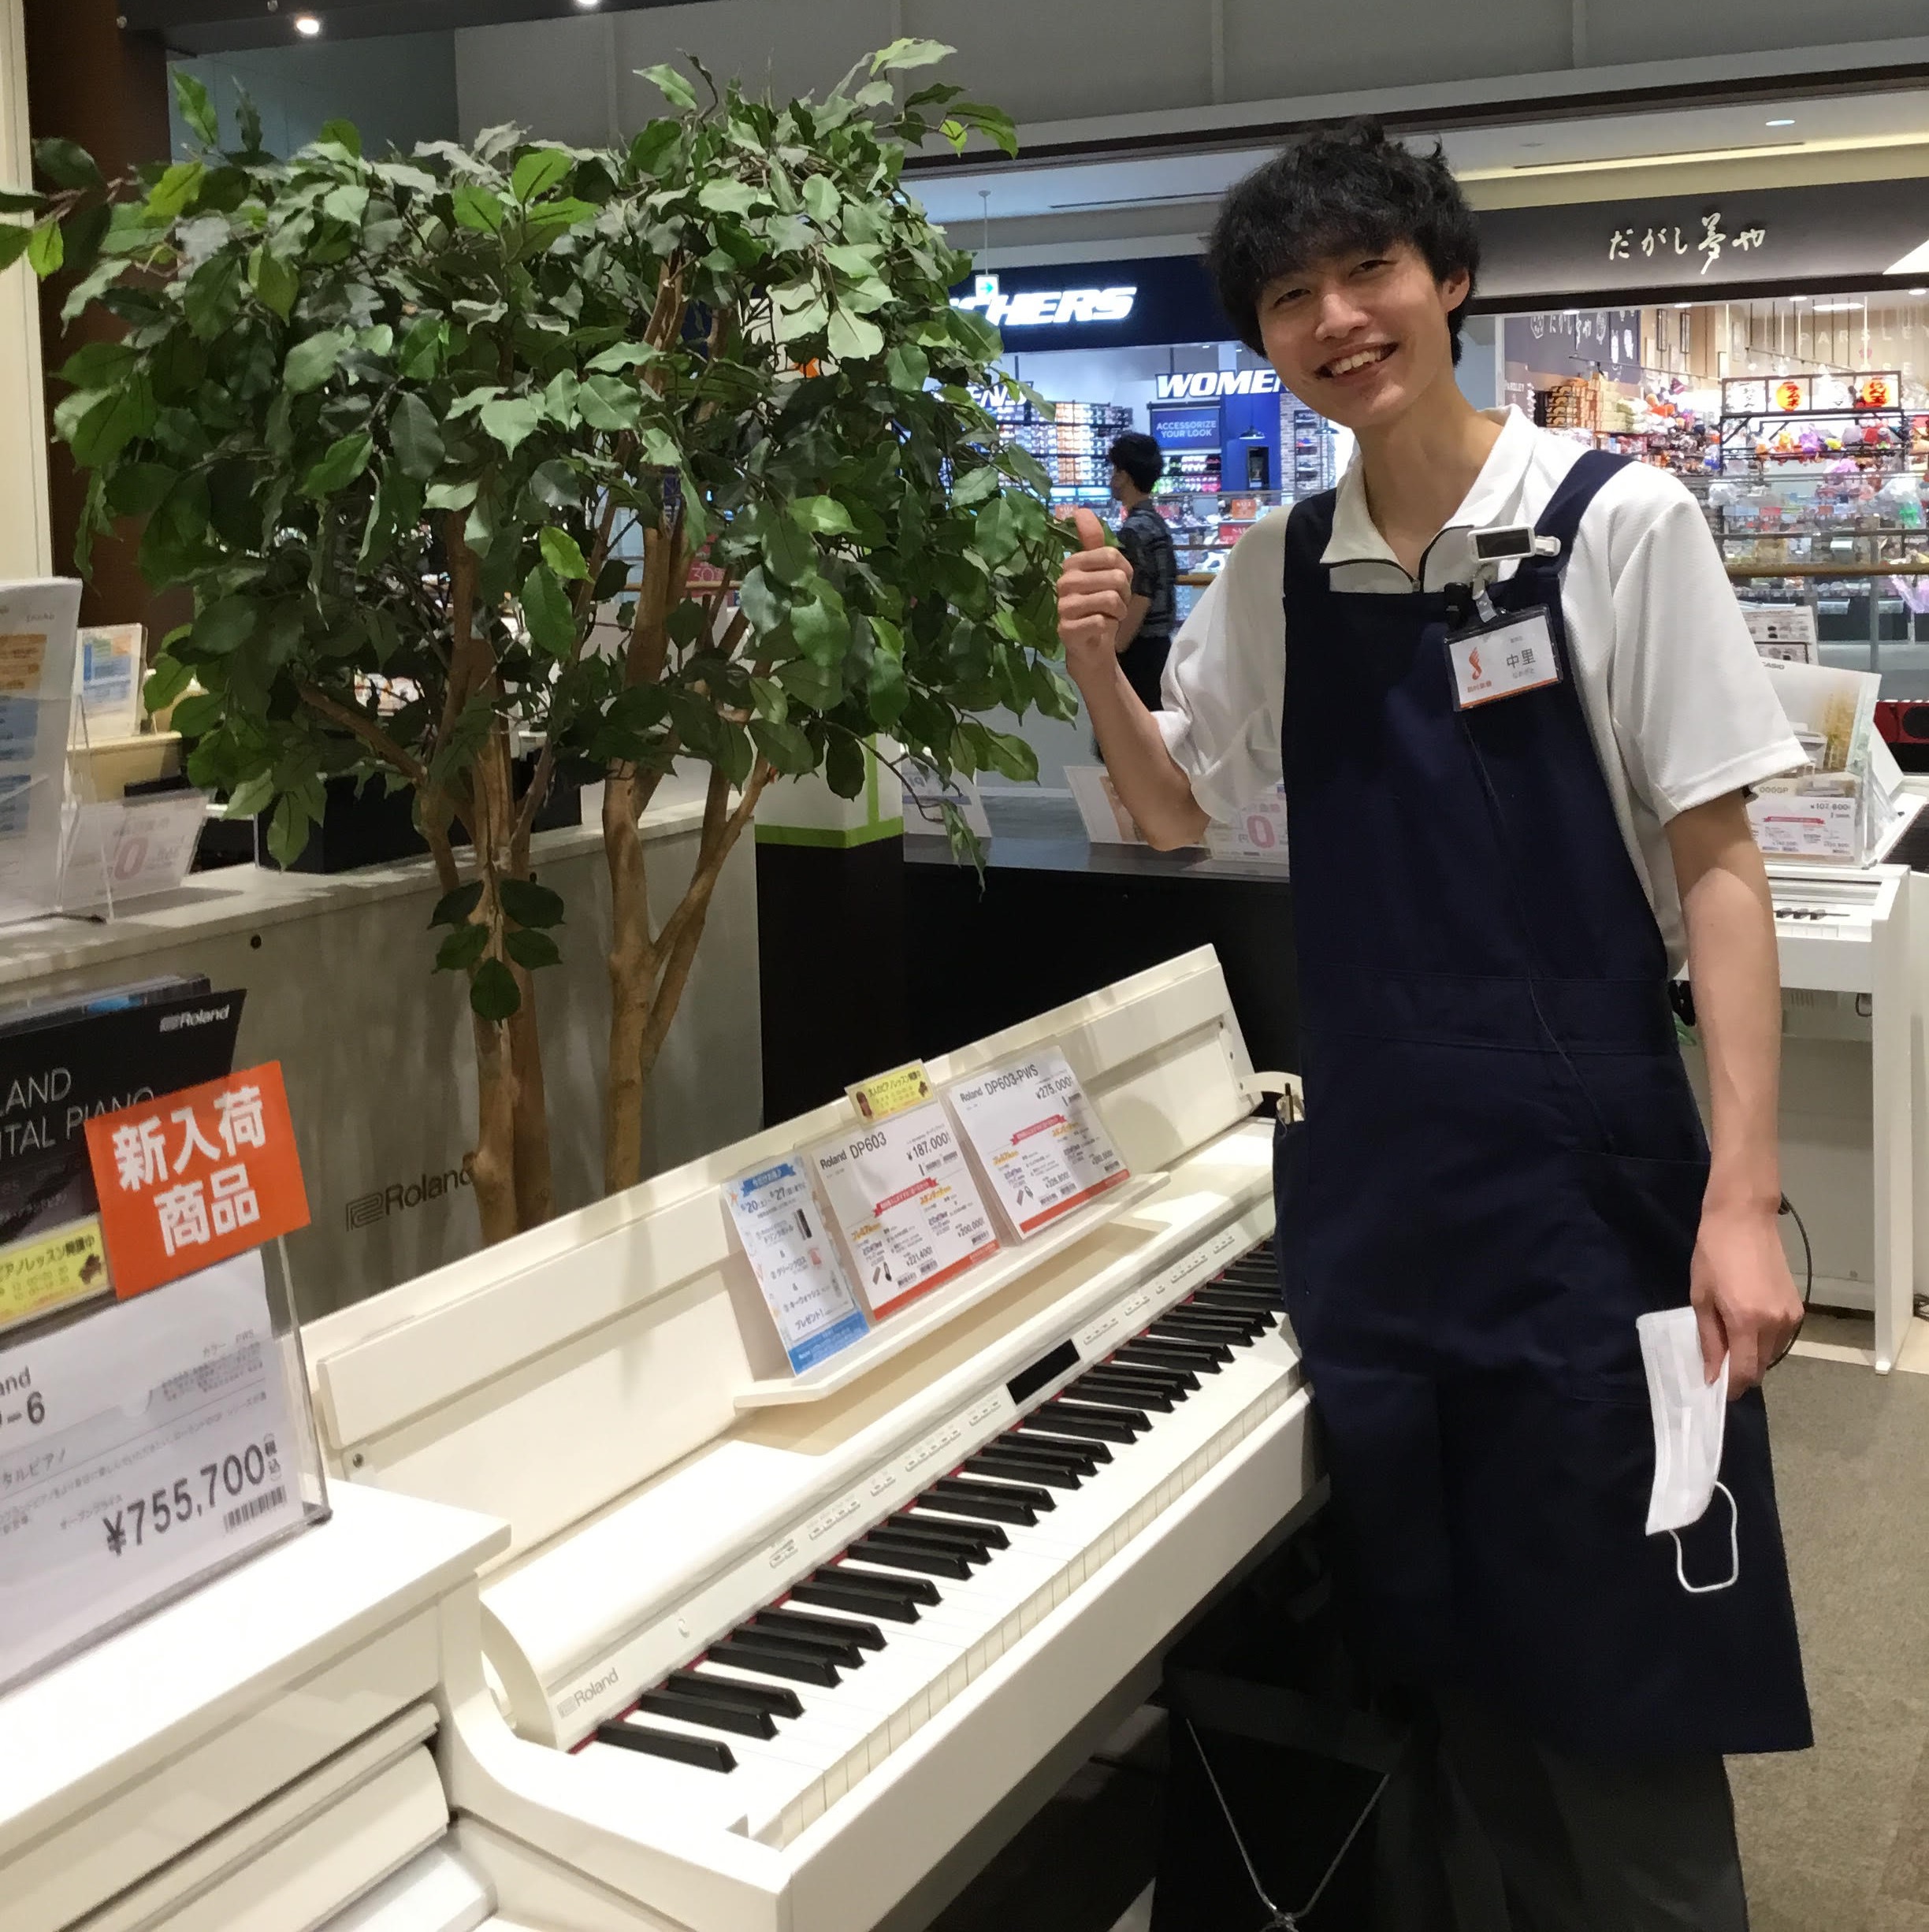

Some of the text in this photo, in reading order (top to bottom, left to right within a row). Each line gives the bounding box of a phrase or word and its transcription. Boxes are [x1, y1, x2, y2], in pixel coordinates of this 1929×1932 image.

[1156, 420, 1217, 431] ACCESSORIZE
[1161, 427, 1213, 438] YOUR LOOK
[1506, 648, 1536, 668] 中里
[179, 1004, 230, 1027] Roland
[0, 1066, 72, 1117] AND
[960, 1064, 1039, 1103] Roland DP603-PWS
[111, 1084, 266, 1192] 新入荷
[820, 1131, 887, 1170] Roland DP603
[154, 1162, 261, 1258] 商品
[102, 1443, 266, 1558] ¥755,700
[574, 1666, 619, 1707] Roland
